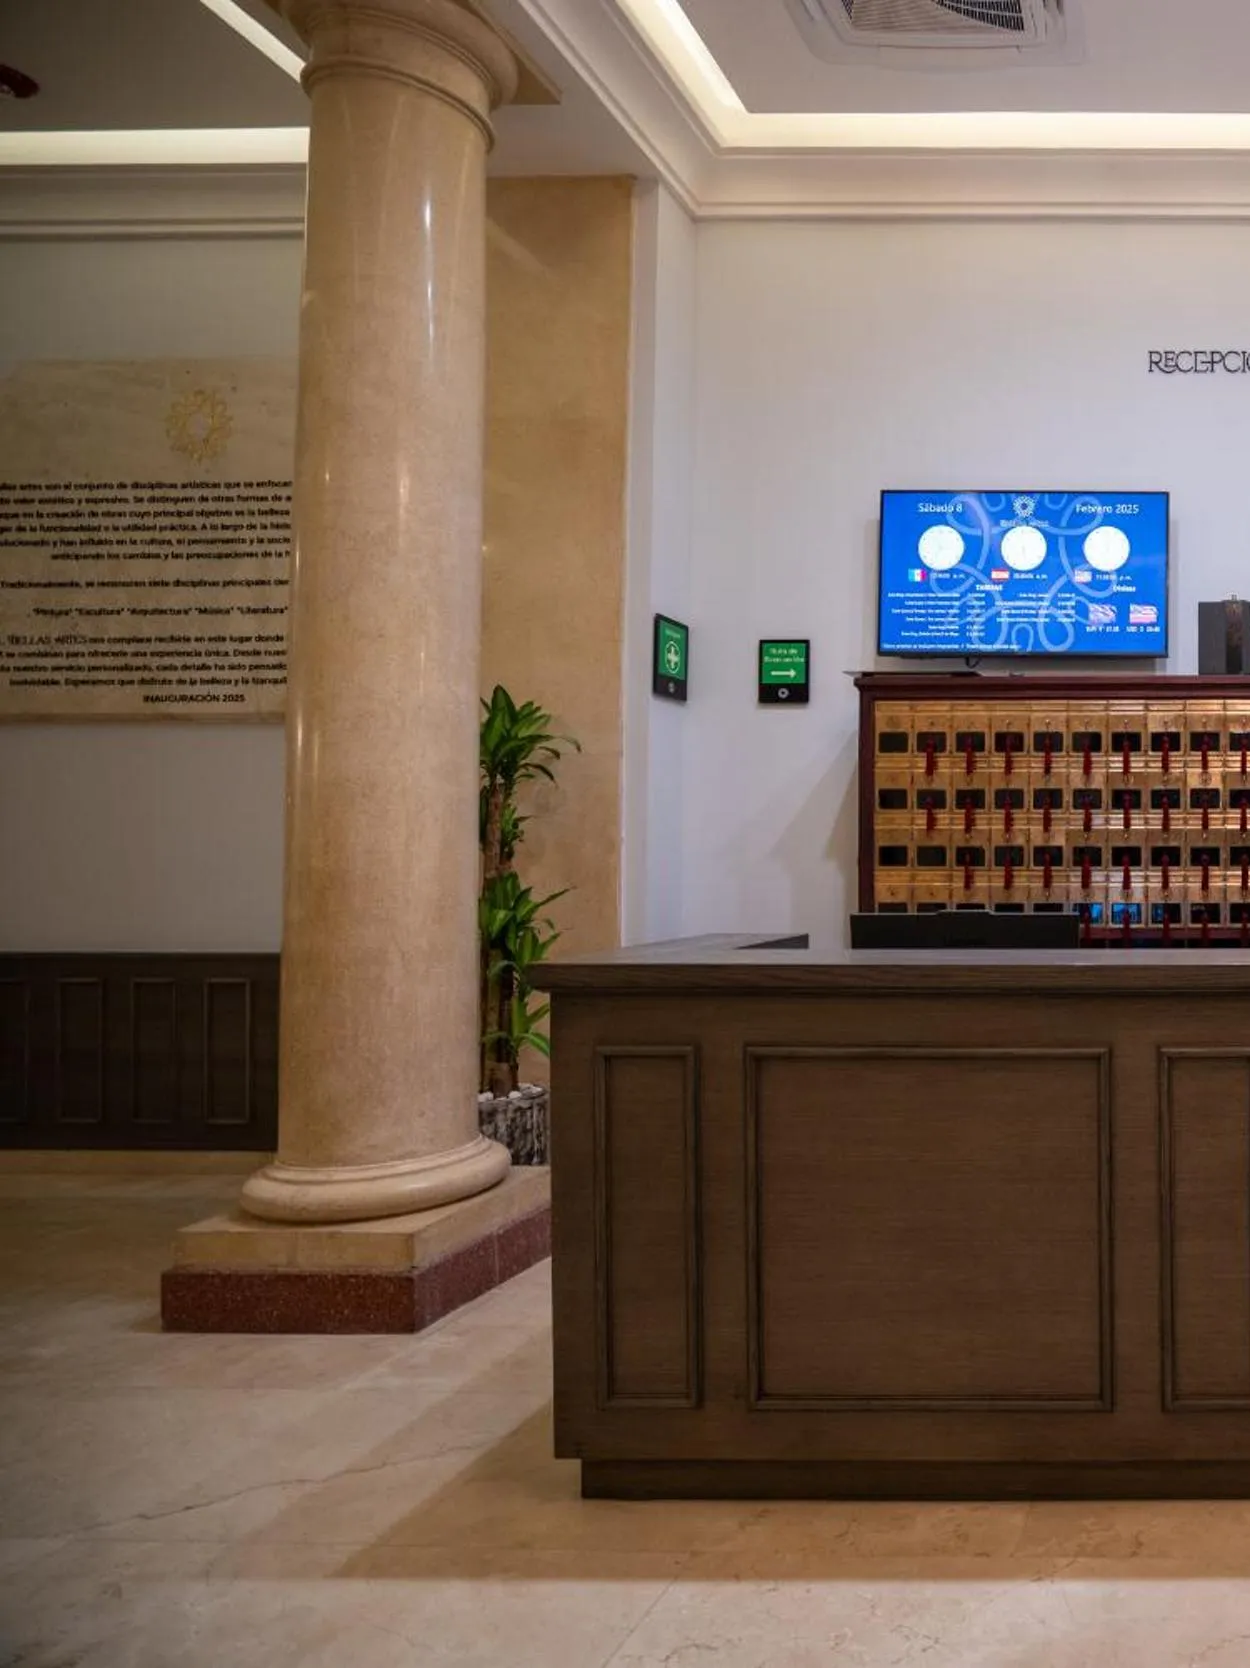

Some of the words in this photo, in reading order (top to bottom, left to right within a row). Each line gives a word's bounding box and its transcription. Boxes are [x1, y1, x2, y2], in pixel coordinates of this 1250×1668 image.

[918, 503, 954, 513] Sábado
[956, 503, 963, 512] 8
[1076, 503, 1113, 513] Febrero
[1115, 503, 1140, 514] 2025
[222, 694, 245, 702] 2025
